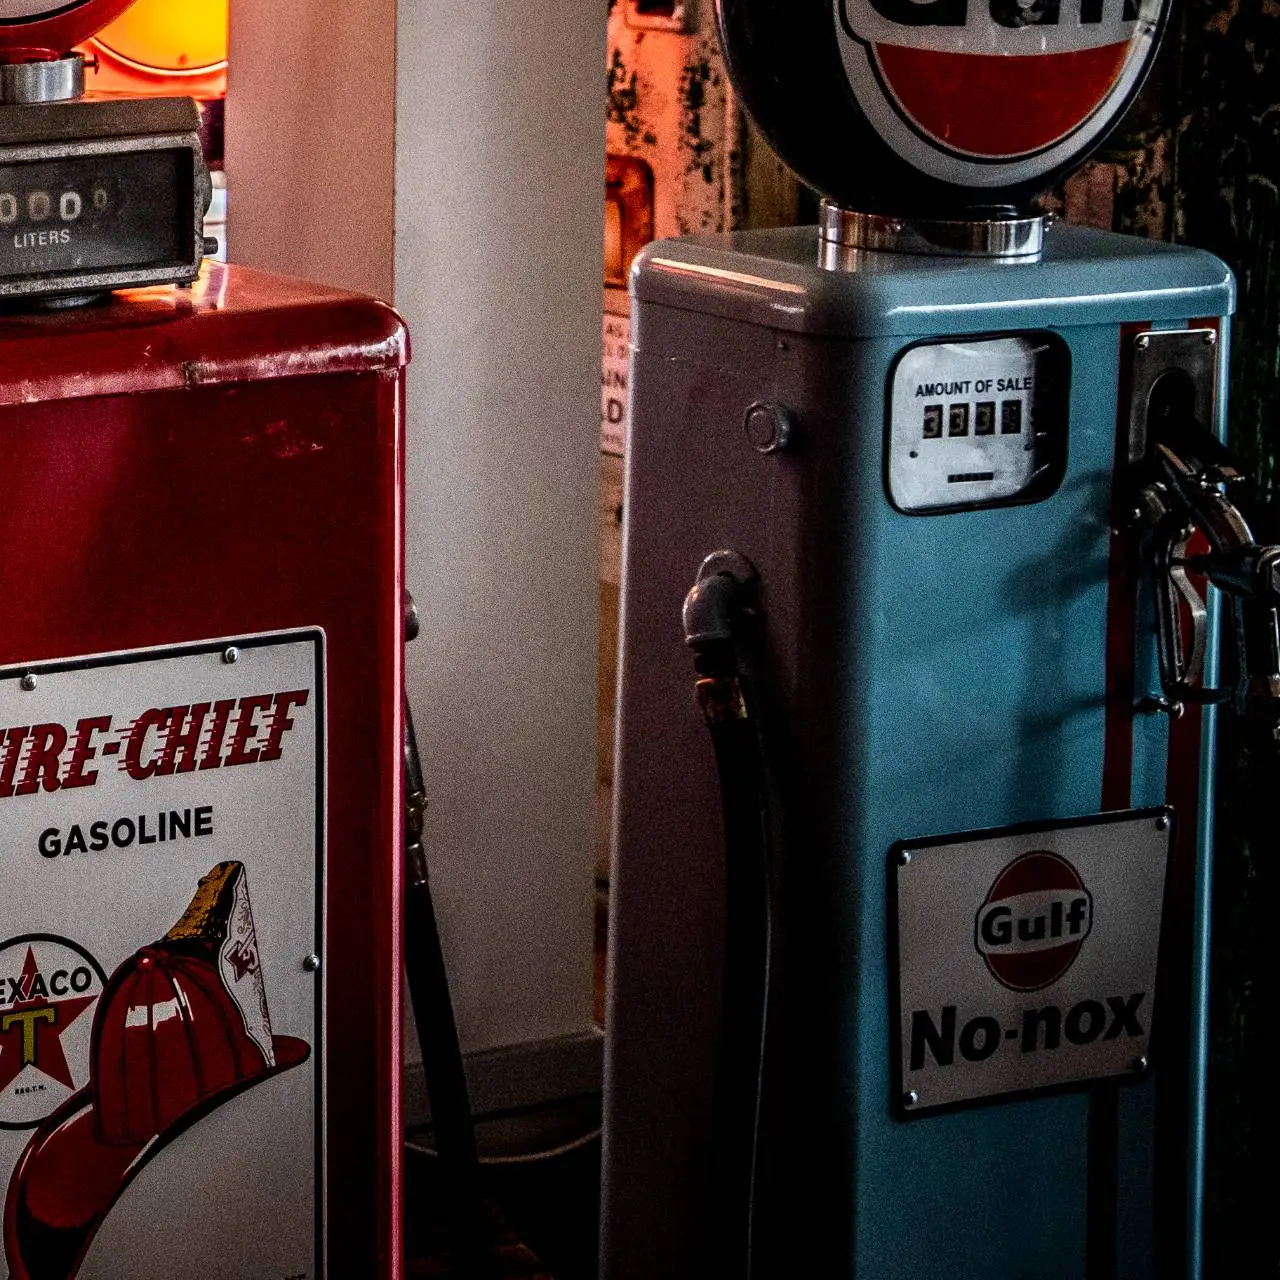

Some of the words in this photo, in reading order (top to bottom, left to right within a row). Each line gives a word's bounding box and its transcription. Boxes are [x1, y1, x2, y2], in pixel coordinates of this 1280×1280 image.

[14, 229, 70, 248] LITERS
[915, 381, 972, 397] AMOUNT
[975, 380, 993, 393] OF
[997, 377, 1032, 392] SALE
[39, 805, 213, 858] GASOLINE
[981, 898, 1087, 947] Gulf
[910, 992, 1146, 1071] No-nox
